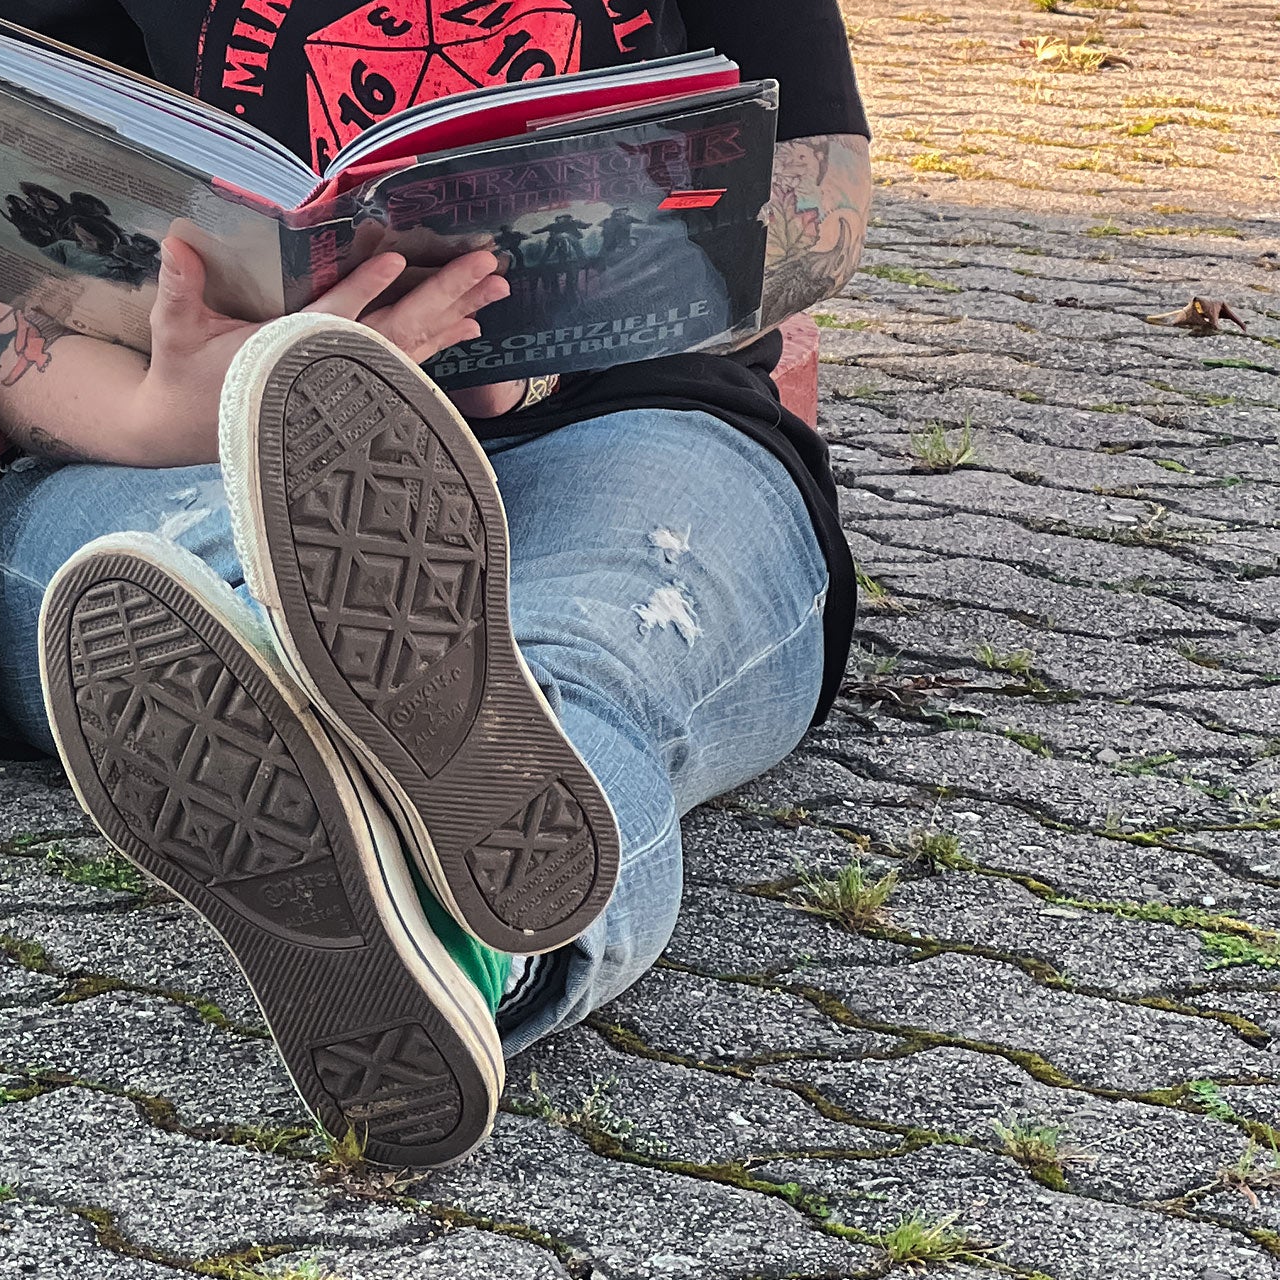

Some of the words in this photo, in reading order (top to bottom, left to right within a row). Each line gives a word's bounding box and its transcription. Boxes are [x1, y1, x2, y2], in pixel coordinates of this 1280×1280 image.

[366, 6, 414, 36] 3
[338, 58, 396, 131] 16
[434, 322, 684, 378] BEGLEITBUCH
[501, 299, 711, 350] OFFIZIELLE
